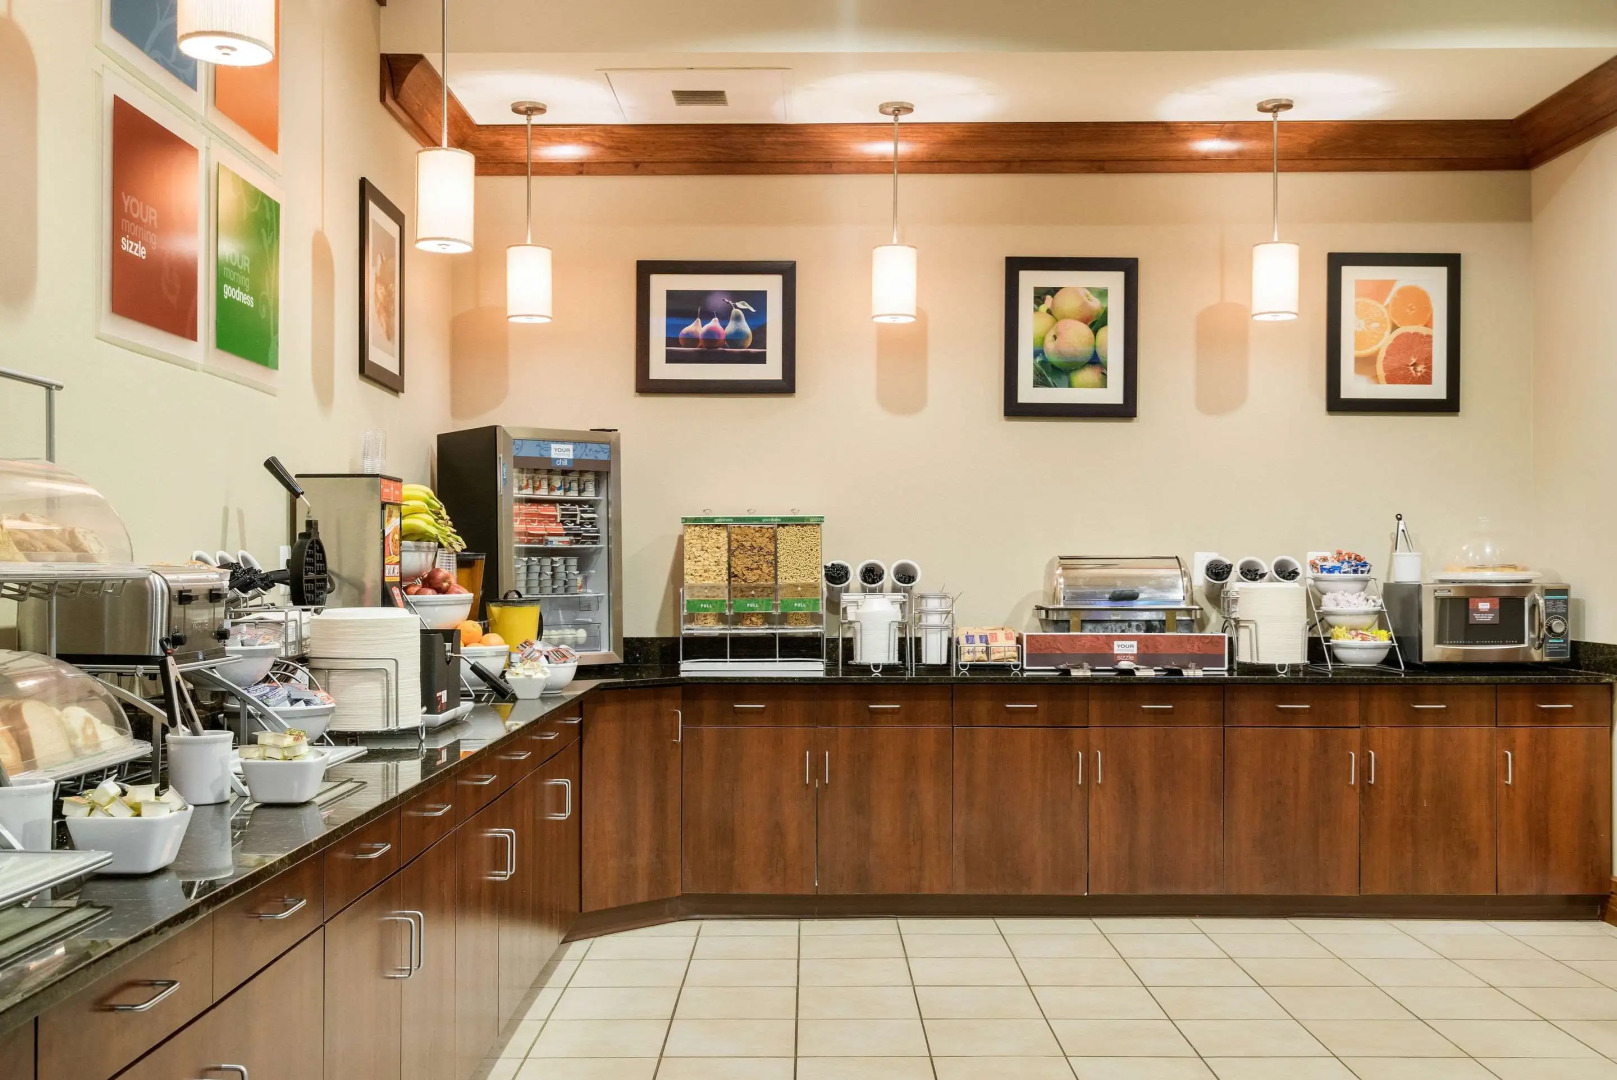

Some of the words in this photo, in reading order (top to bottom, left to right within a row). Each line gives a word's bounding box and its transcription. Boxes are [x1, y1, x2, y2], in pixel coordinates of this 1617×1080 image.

[121, 191, 158, 229] YOUR
[121, 218, 157, 250] morning
[121, 234, 147, 260] sizzle
[223, 248, 250, 274] YOUR
[223, 266, 250, 292] morning
[223, 283, 254, 308] goodness
